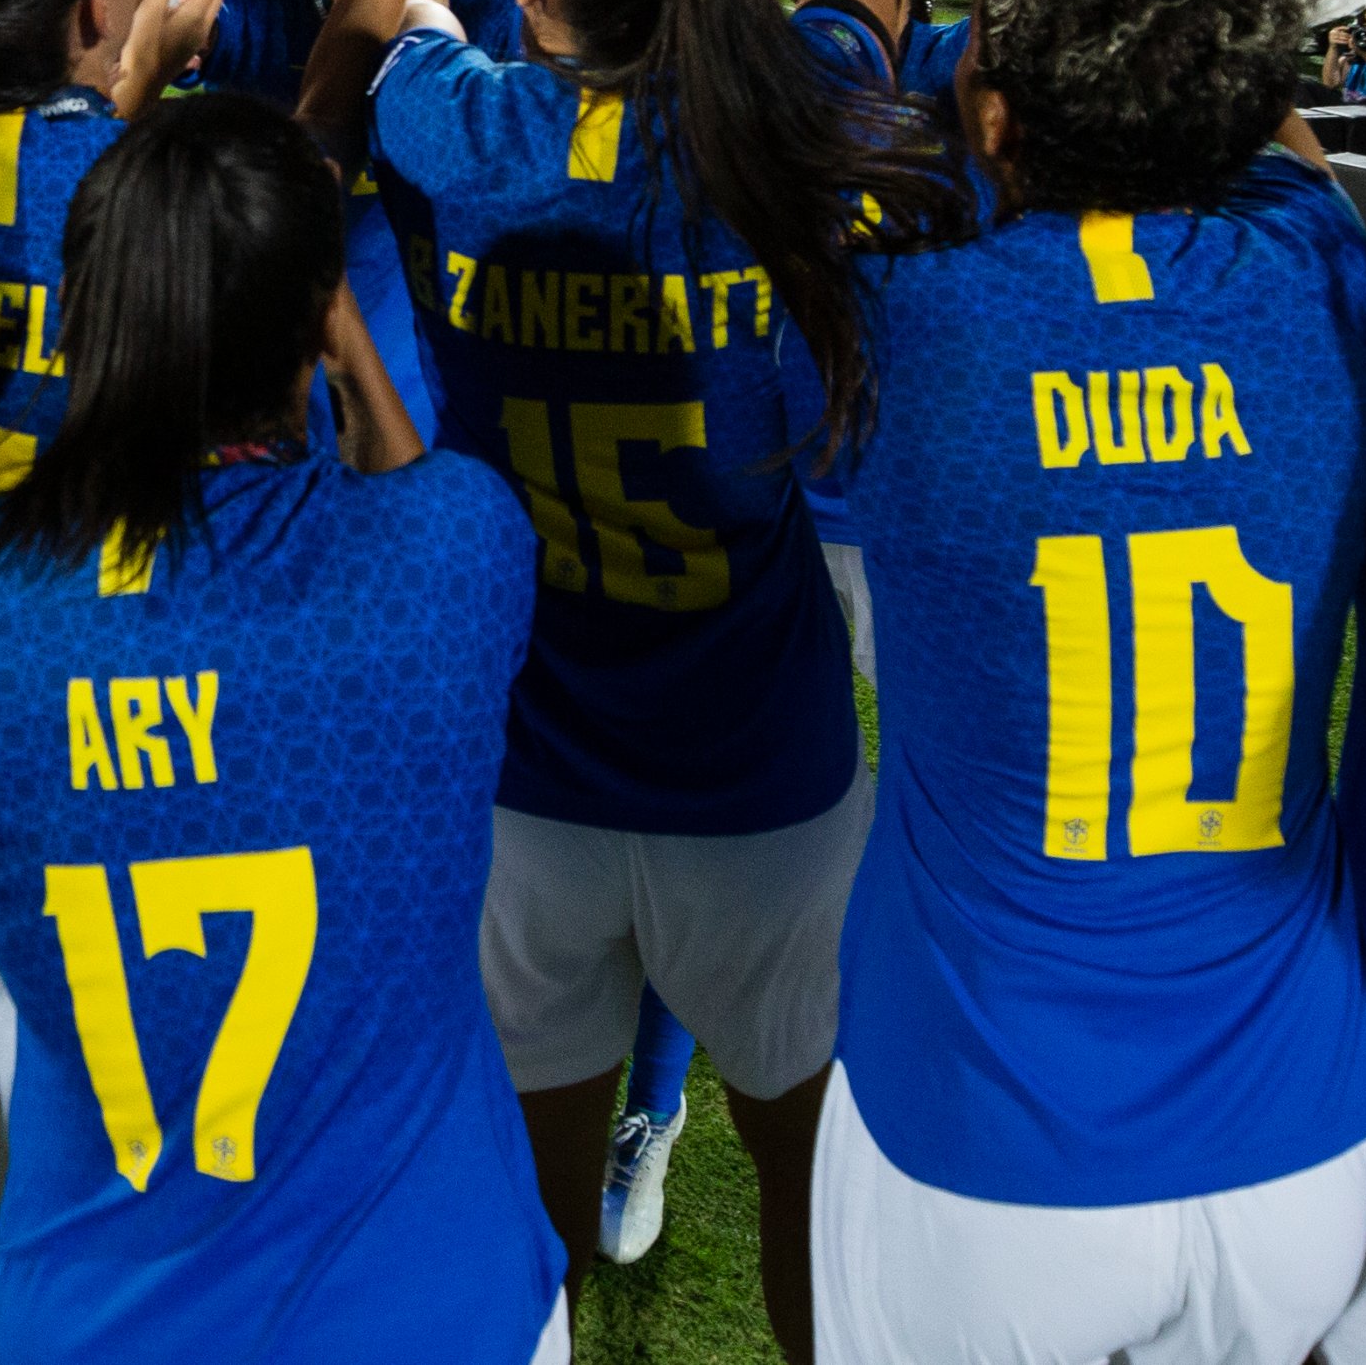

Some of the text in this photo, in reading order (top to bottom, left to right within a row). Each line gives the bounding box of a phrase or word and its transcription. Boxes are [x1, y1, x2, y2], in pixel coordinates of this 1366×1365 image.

[446, 251, 774, 354] ZANERATT
[1031, 363, 1252, 469] DUDA
[501, 397, 731, 612] 16
[66, 670, 220, 790] ARY
[1030, 525, 1295, 862] 10
[42, 845, 319, 1193] 17
